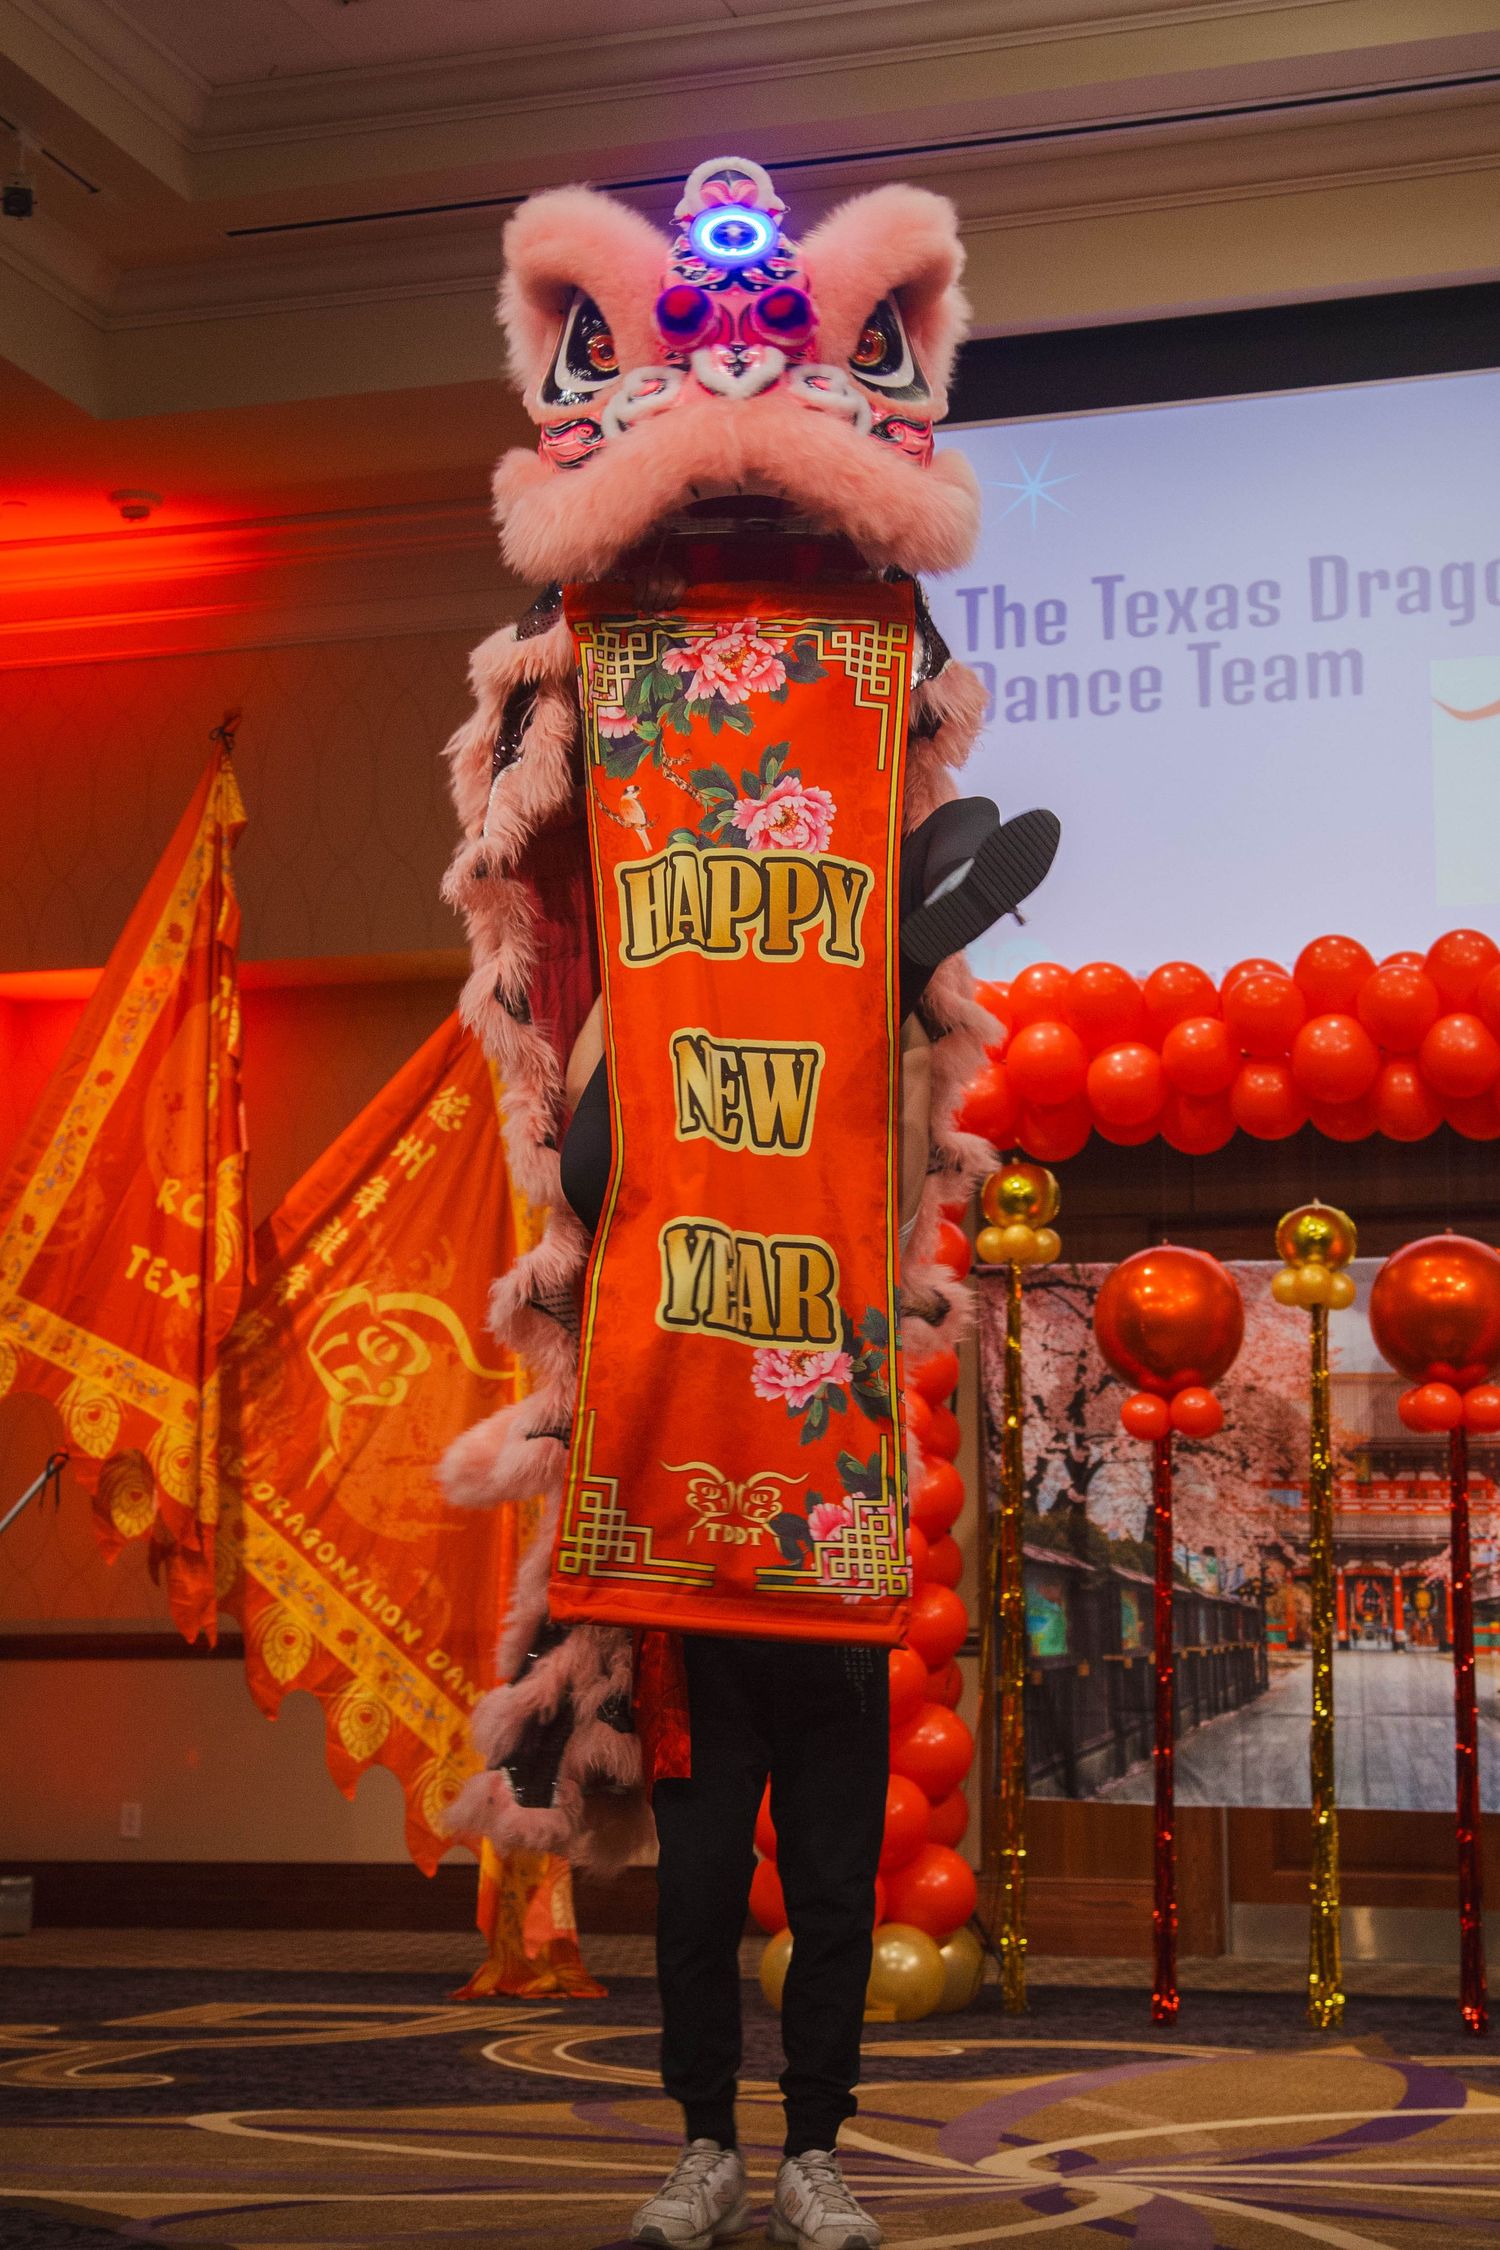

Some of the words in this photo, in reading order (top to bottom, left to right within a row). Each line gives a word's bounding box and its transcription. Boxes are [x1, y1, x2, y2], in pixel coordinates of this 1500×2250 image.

[956, 585, 1067, 652] The
[1091, 574, 1281, 640] Texas
[1187, 641, 1364, 707] Team
[617, 846, 871, 965] HAPPY
[671, 1030, 823, 1154] NEW
[659, 1220, 841, 1347] YEAR
[704, 1522, 763, 1546] TDDT
